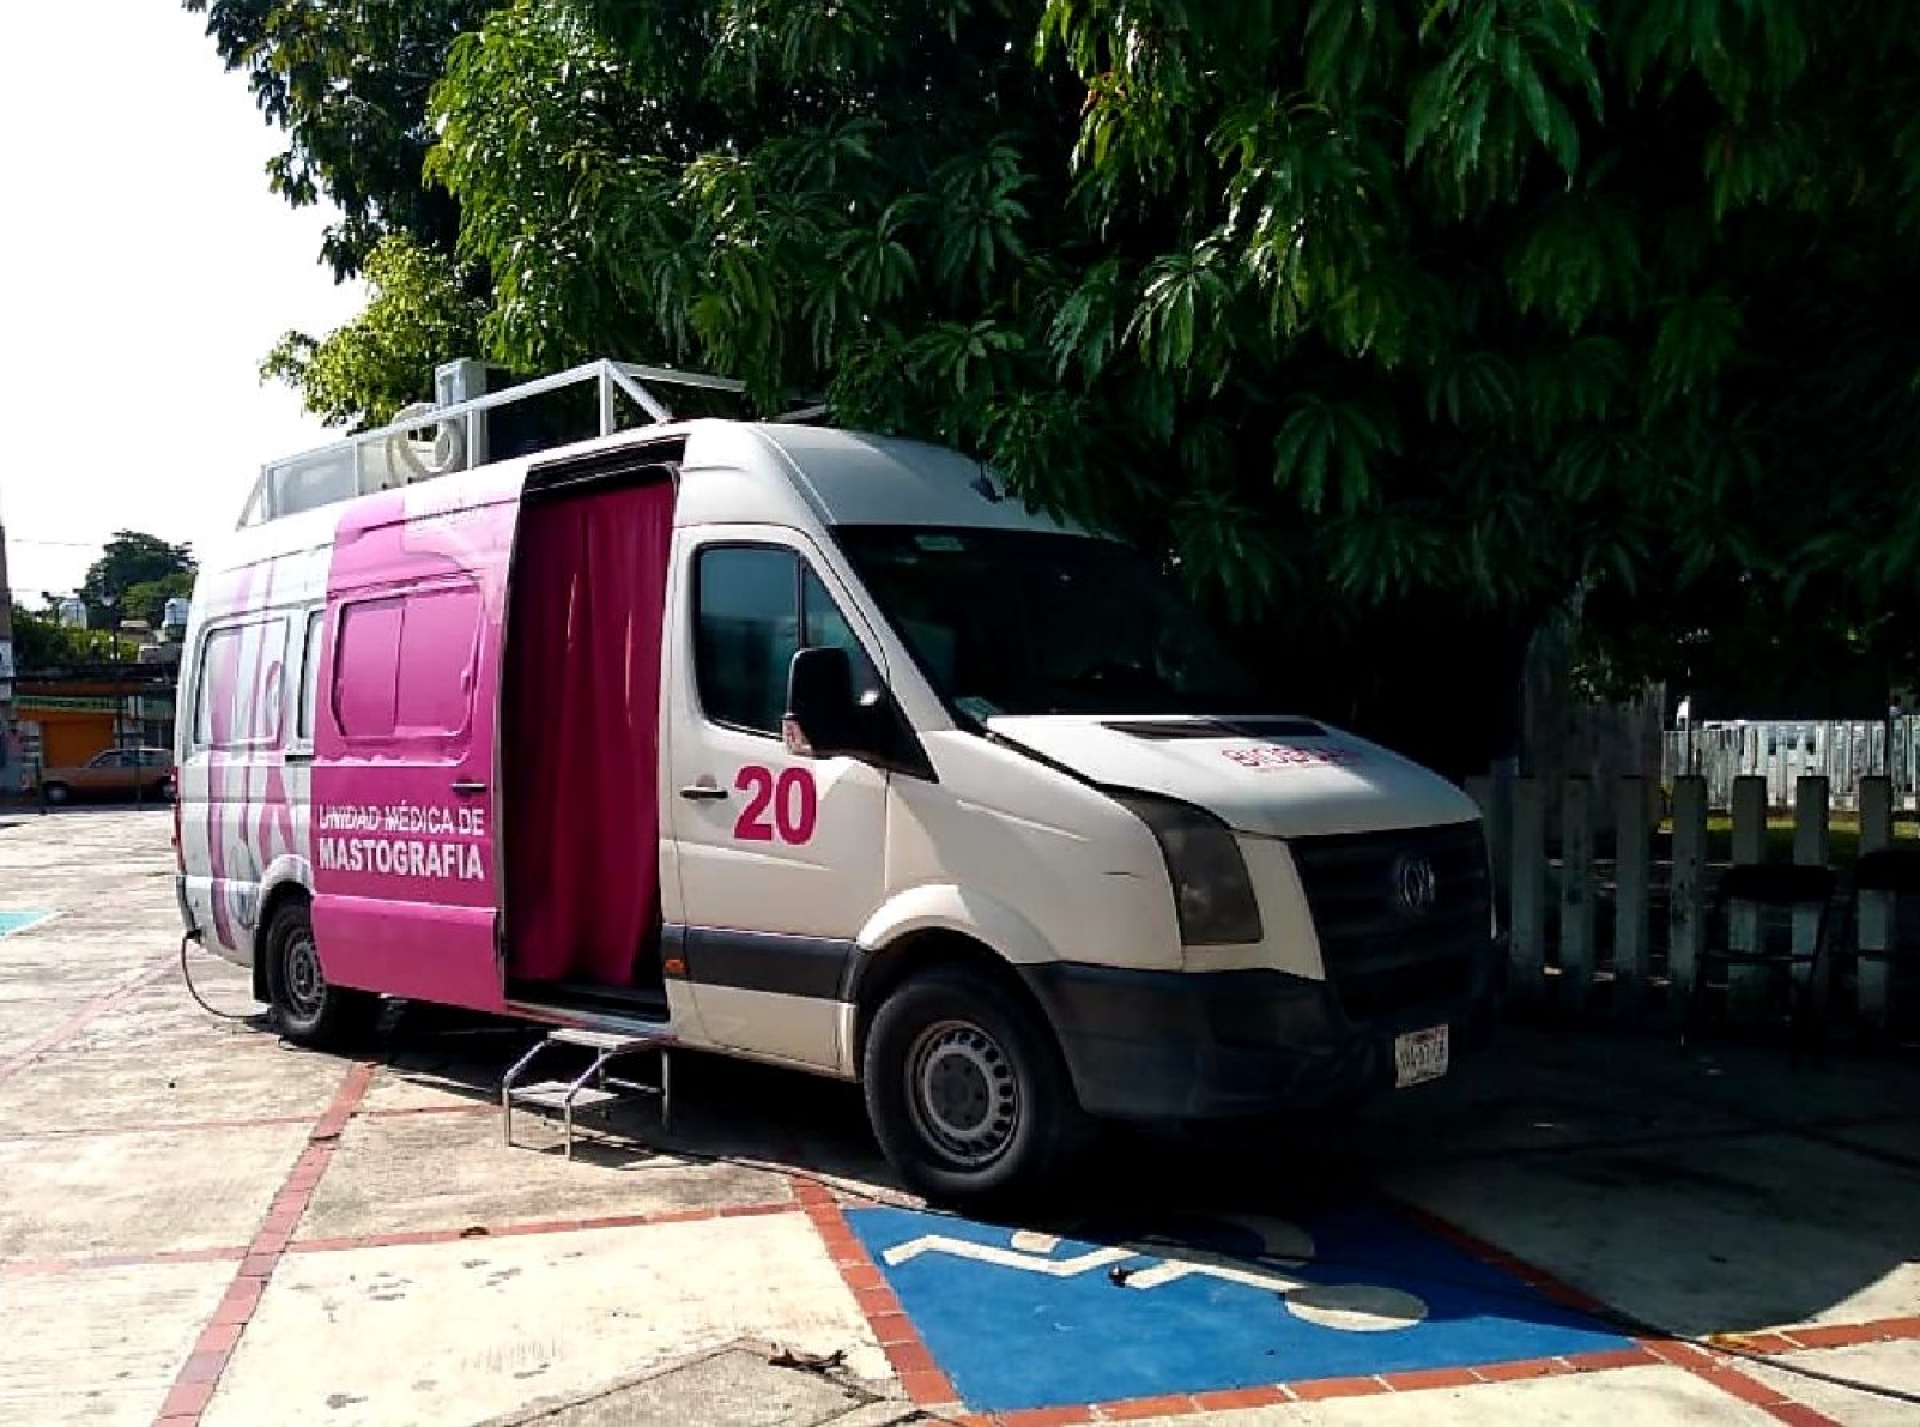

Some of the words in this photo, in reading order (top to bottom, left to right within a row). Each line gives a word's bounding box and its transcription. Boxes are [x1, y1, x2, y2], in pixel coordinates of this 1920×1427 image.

[319, 803, 378, 830] UNIDAD
[385, 800, 454, 834] MÉDICA
[459, 806, 485, 836] DE
[734, 766, 816, 845] 20
[319, 837, 485, 880] MASTOGRAFIA
